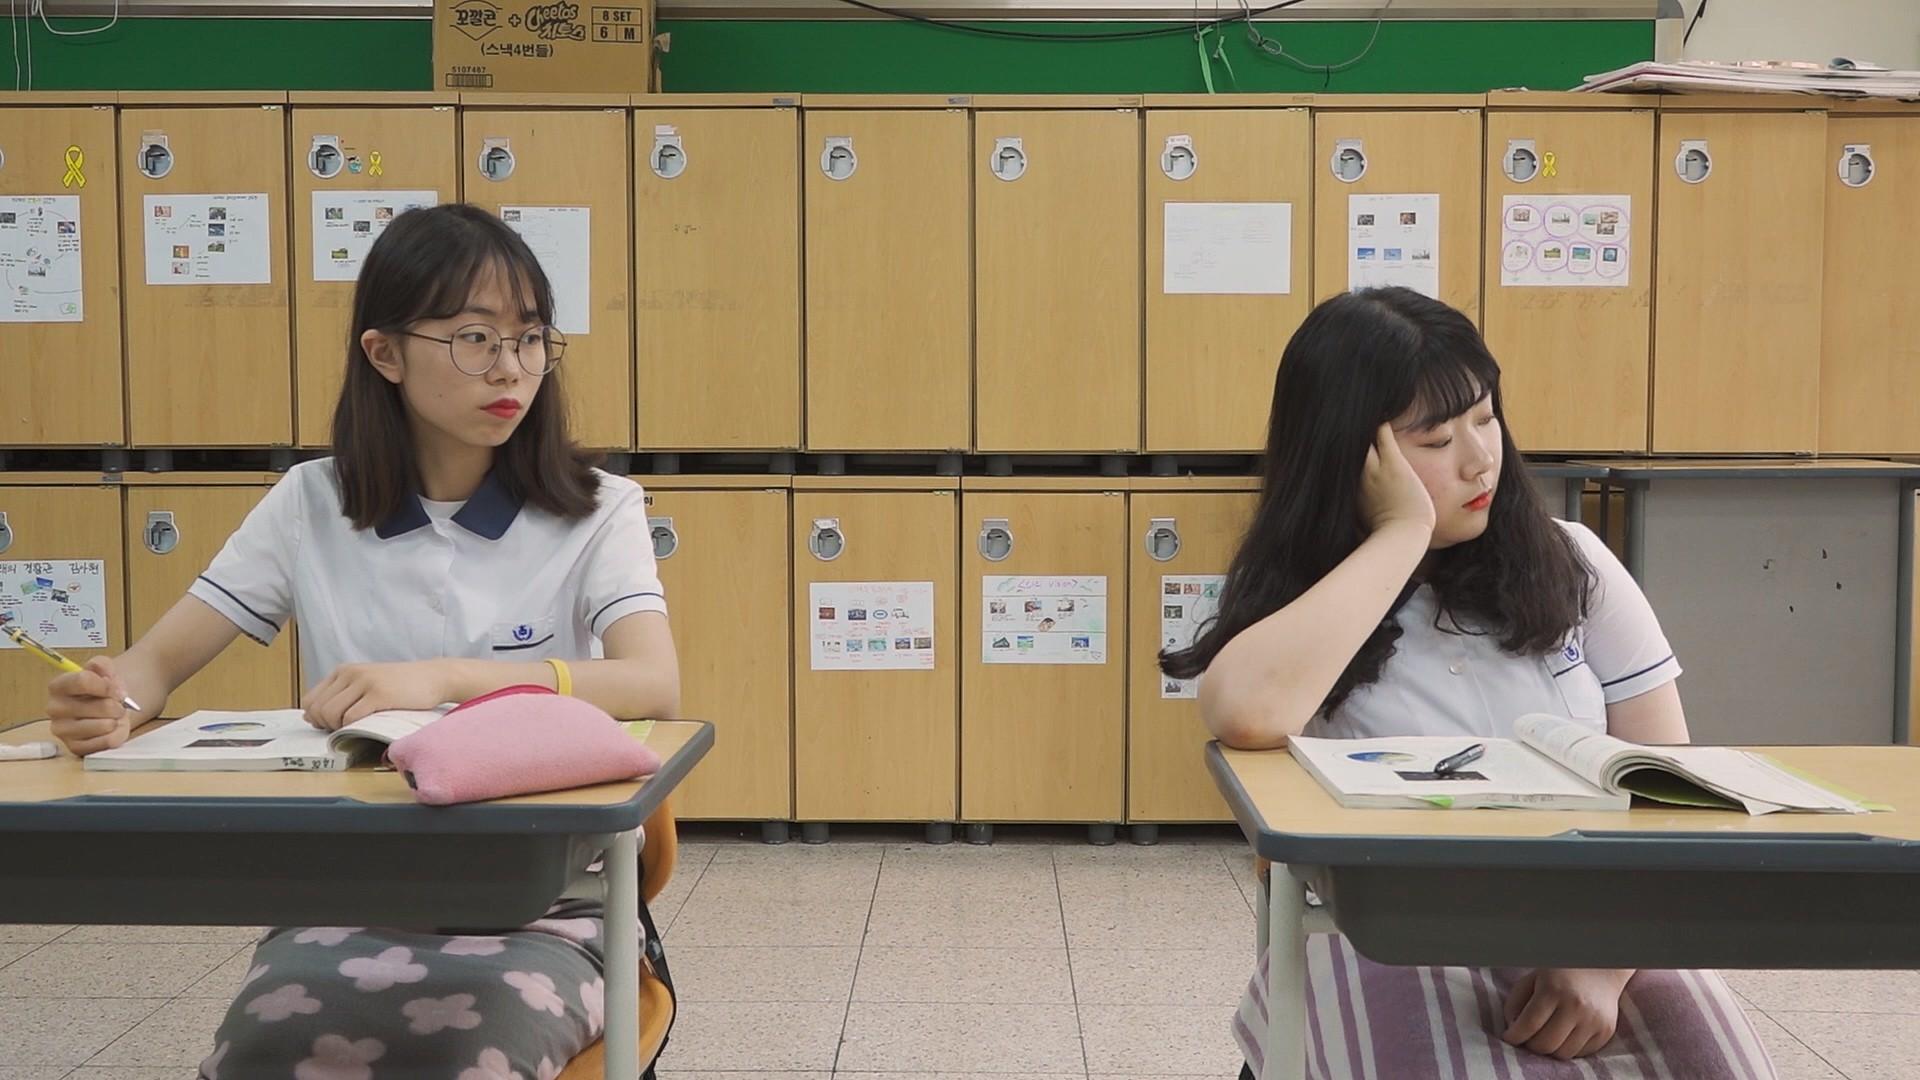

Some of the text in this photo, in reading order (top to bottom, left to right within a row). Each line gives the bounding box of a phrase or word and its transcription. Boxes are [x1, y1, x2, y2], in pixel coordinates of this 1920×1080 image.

[455, 9, 497, 26] 꼬깔콘
[525, 0, 579, 32] Cheetos
[602, 10, 631, 21] 8 SET
[538, 21, 586, 41] 치토스
[600, 26, 635, 40] 6 M
[481, 42, 553, 57] (스낵4번들)
